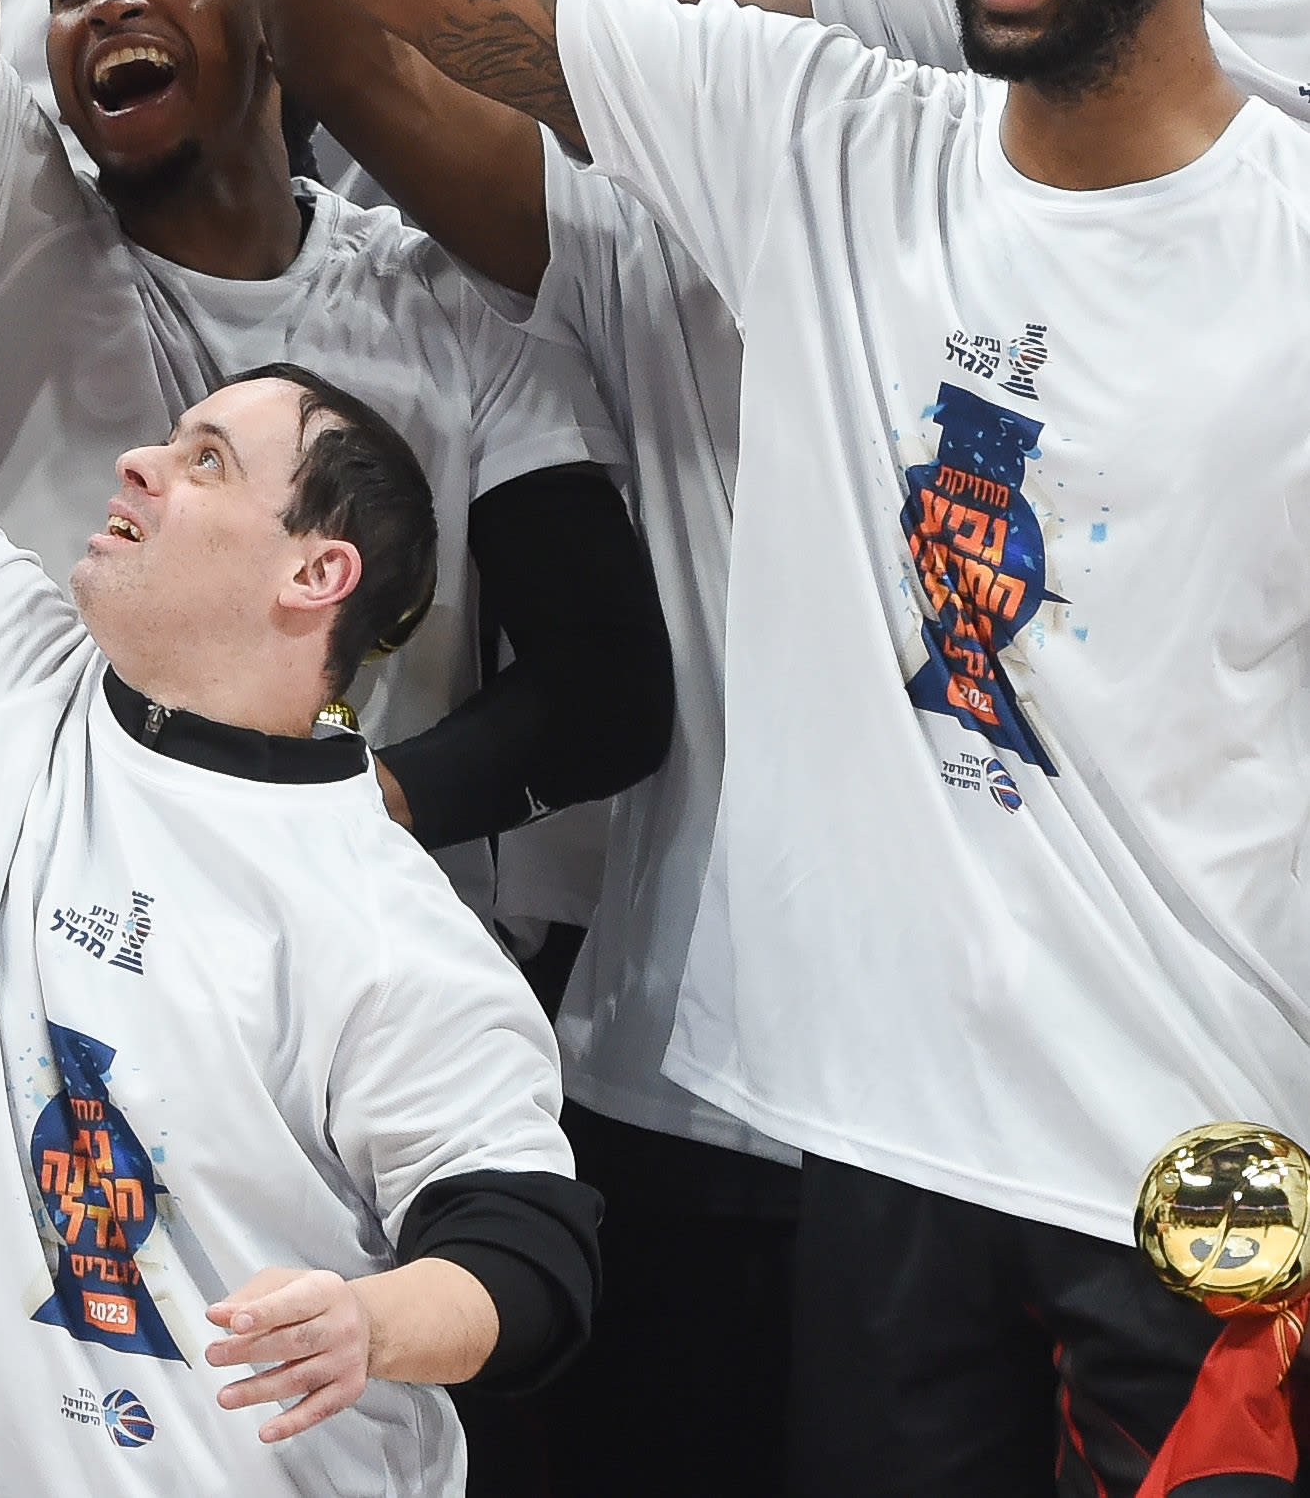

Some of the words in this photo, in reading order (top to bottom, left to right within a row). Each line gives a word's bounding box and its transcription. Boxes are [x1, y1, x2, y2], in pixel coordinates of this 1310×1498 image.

[945, 336, 994, 380] מגדל
[935, 464, 1011, 508] מחזיקת
[920, 488, 1009, 567] גביע
[958, 684, 994, 714] 202
[49, 908, 106, 960] מגדל
[65, 906, 114, 942] המדינה
[87, 1300, 129, 1325] 2023
